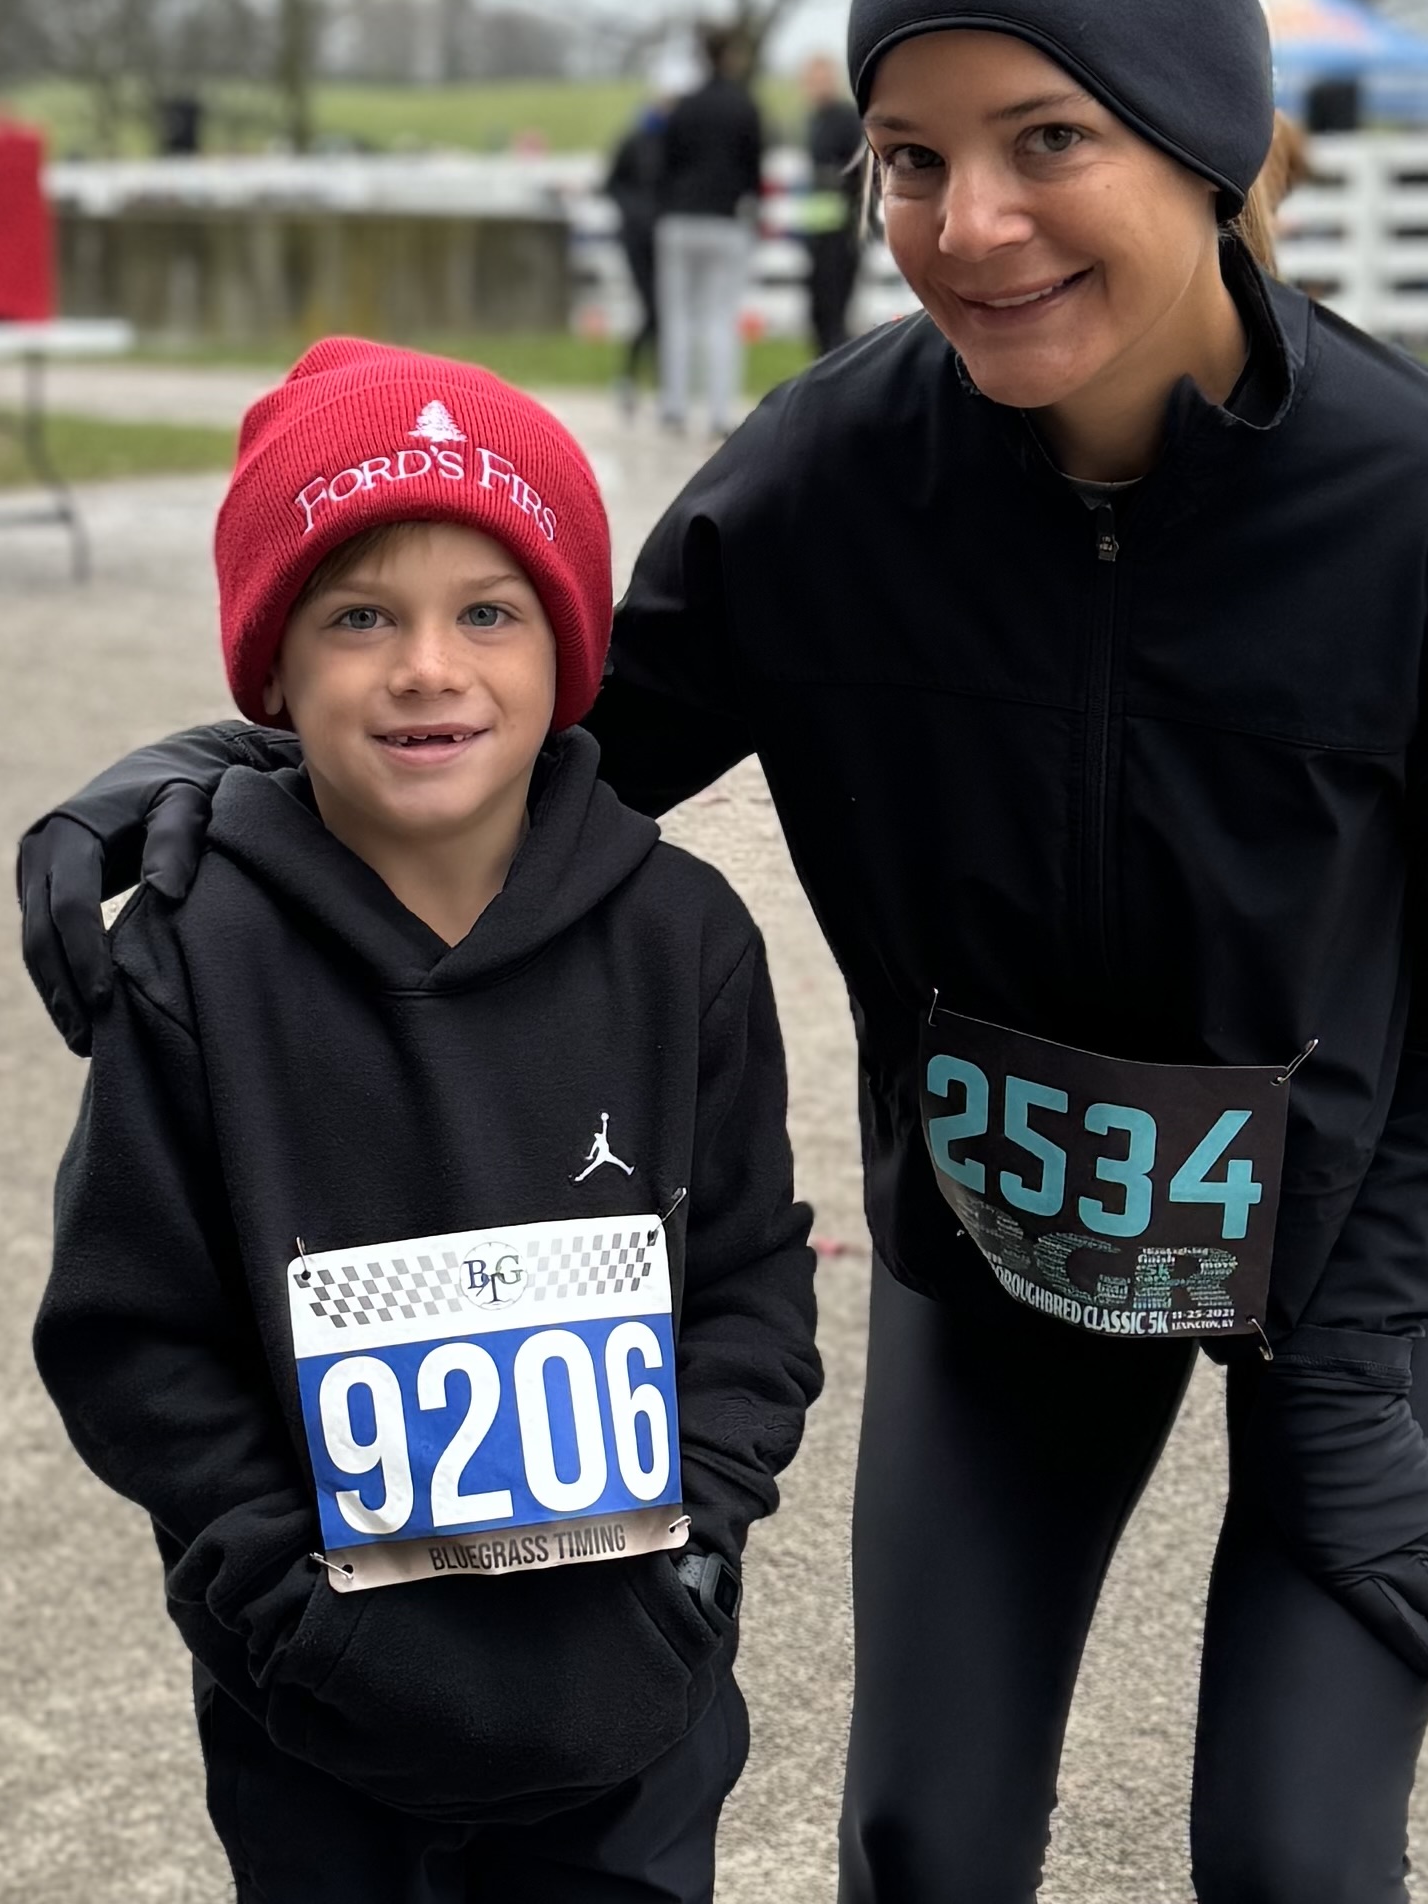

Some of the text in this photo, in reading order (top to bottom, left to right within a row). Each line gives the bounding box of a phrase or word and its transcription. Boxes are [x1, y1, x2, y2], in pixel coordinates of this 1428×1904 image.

[475, 447, 558, 542] FIRS
[926, 1053, 1263, 1240] 2534
[1082, 1305, 1147, 1335] CLASSIC
[1147, 1309, 1170, 1334] 5K
[1171, 1307, 1235, 1320] 11-25-2021
[318, 1320, 671, 1536] 9206
[427, 1523, 627, 1572] BLUEGRASS TIMING
